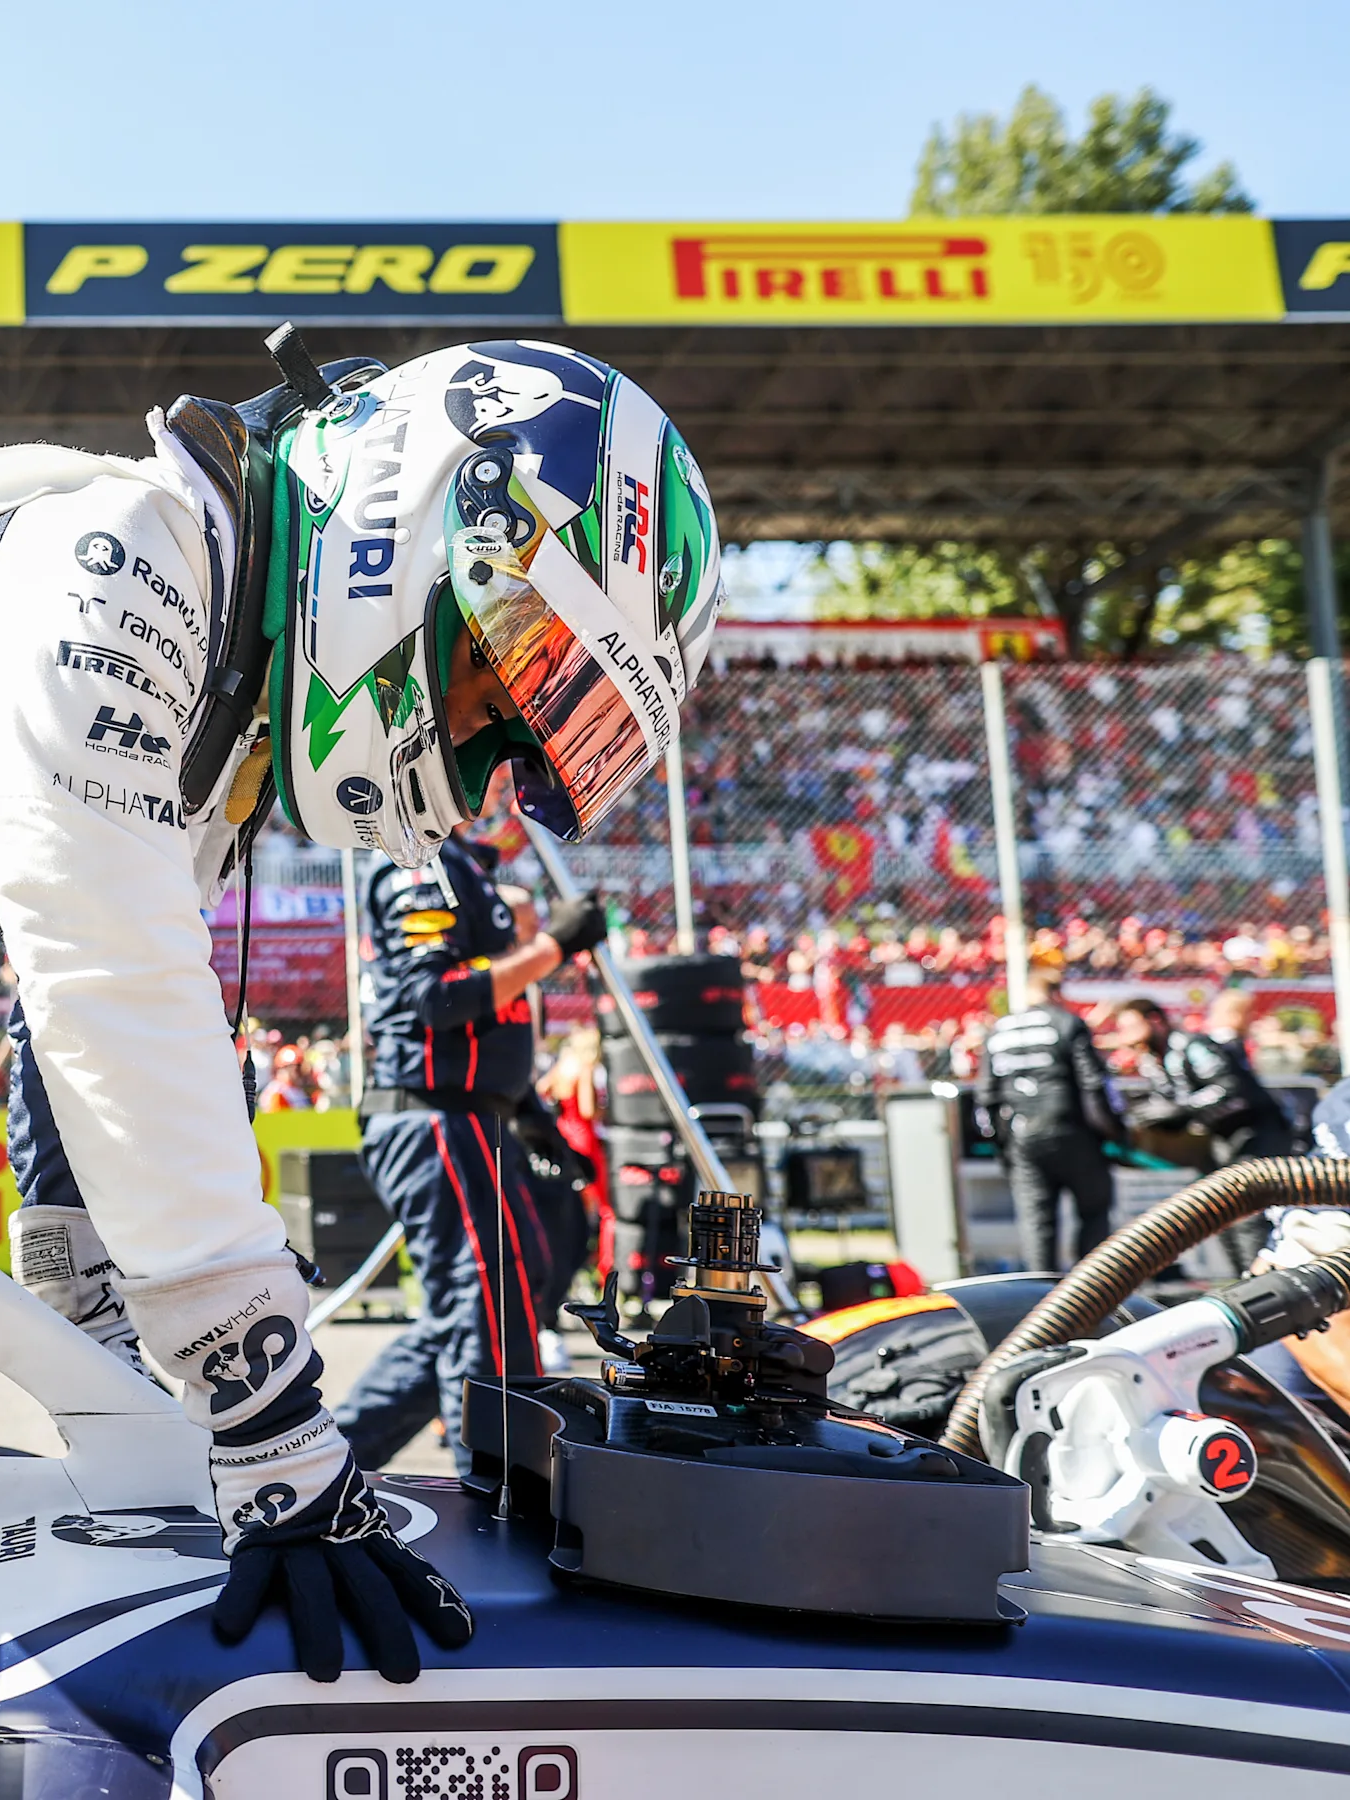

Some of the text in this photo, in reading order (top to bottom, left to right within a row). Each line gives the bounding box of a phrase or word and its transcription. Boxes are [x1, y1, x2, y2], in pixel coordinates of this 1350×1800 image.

[47, 243, 536, 294] P ZERO
[671, 234, 991, 301] PIRELLI
[613, 514, 623, 562] RACING
[620, 473, 649, 575] HRC
[85, 741, 139, 760] Honda
[173, 1287, 272, 1361] ALPHATAURI
[1205, 1437, 1250, 1490] 2
